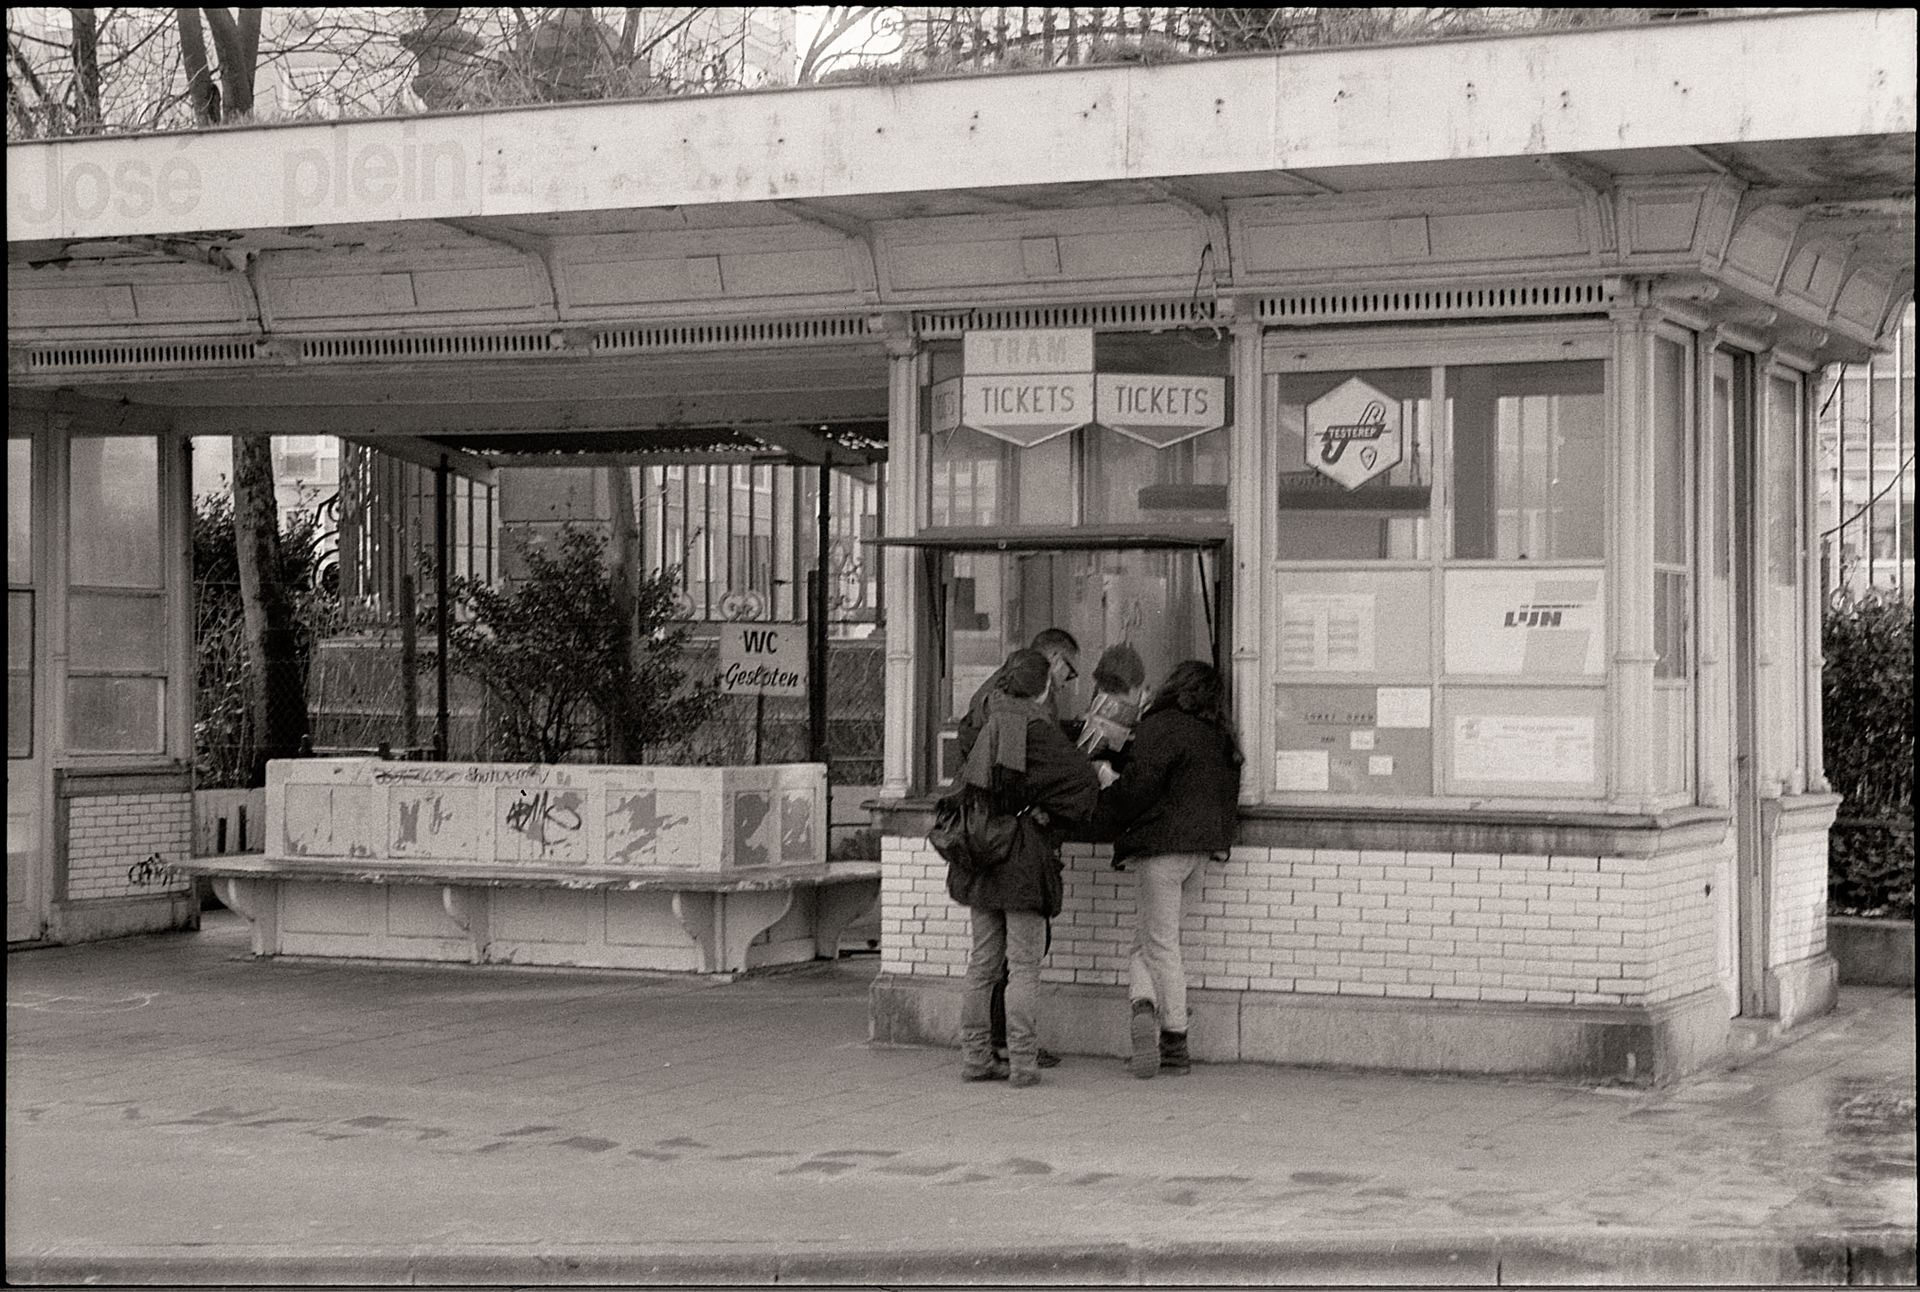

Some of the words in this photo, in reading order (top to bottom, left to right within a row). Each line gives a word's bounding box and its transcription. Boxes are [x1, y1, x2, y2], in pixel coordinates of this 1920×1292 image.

[17, 137, 202, 224] José
[283, 121, 467, 222] plein
[990, 336, 1069, 364] TRAM
[981, 385, 1075, 415] TICKETS
[1114, 385, 1209, 416] TICKETS
[1328, 426, 1378, 440] TESTEREP
[743, 630, 779, 655] WC
[725, 662, 799, 691] Gesloten
